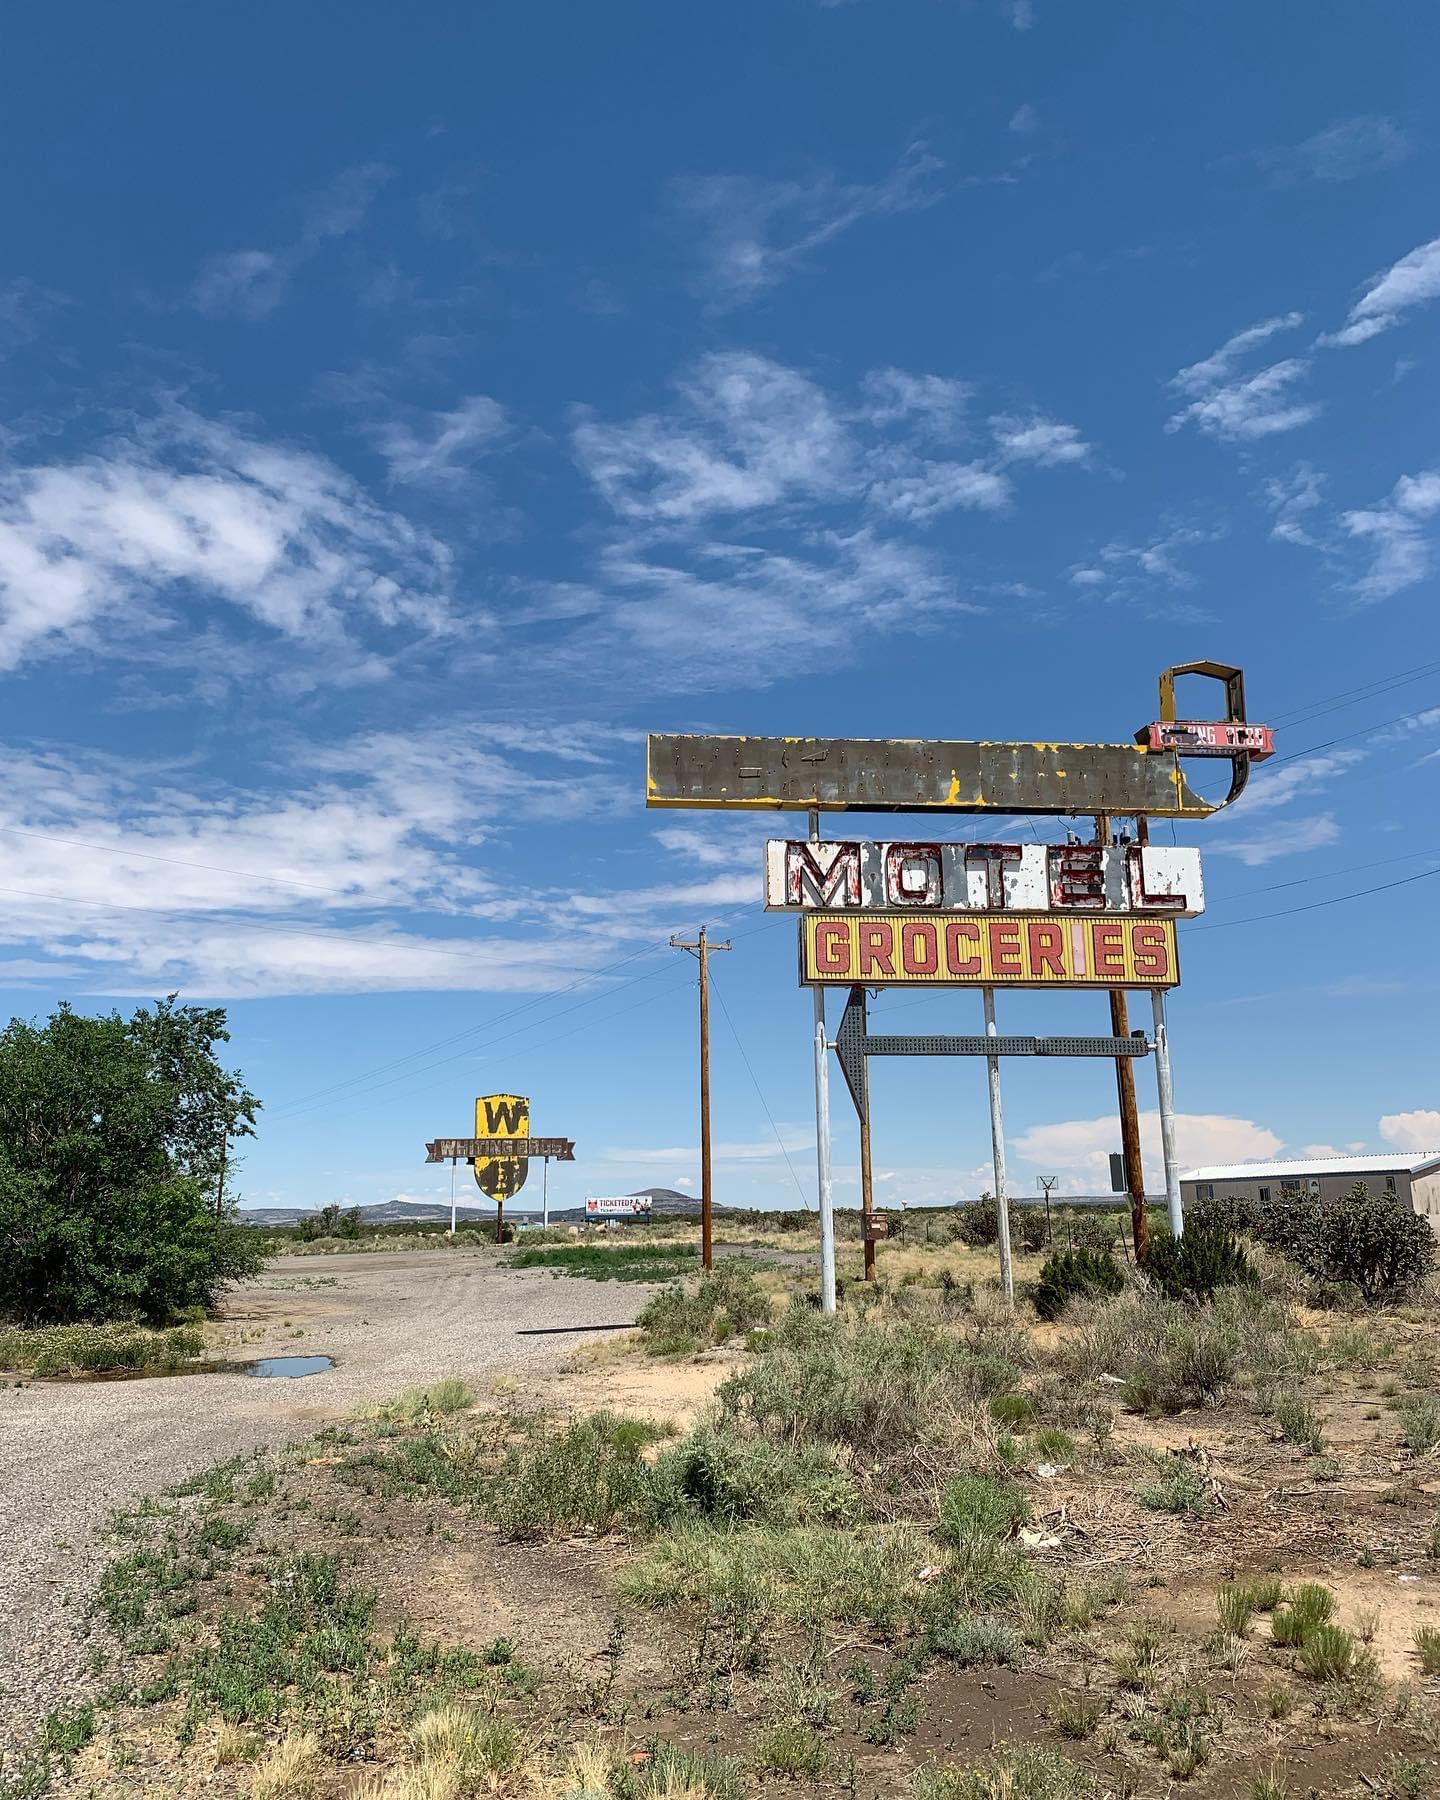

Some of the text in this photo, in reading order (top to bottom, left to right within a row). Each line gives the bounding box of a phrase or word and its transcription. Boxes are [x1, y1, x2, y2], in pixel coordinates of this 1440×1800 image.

[786, 841, 1187, 910] MOTEL
[815, 921, 1168, 977] GROCERIES
[484, 1101, 523, 1134] W
[440, 1140, 513, 1156] WHITING
[600, 1199, 634, 1207] TICKETED?
